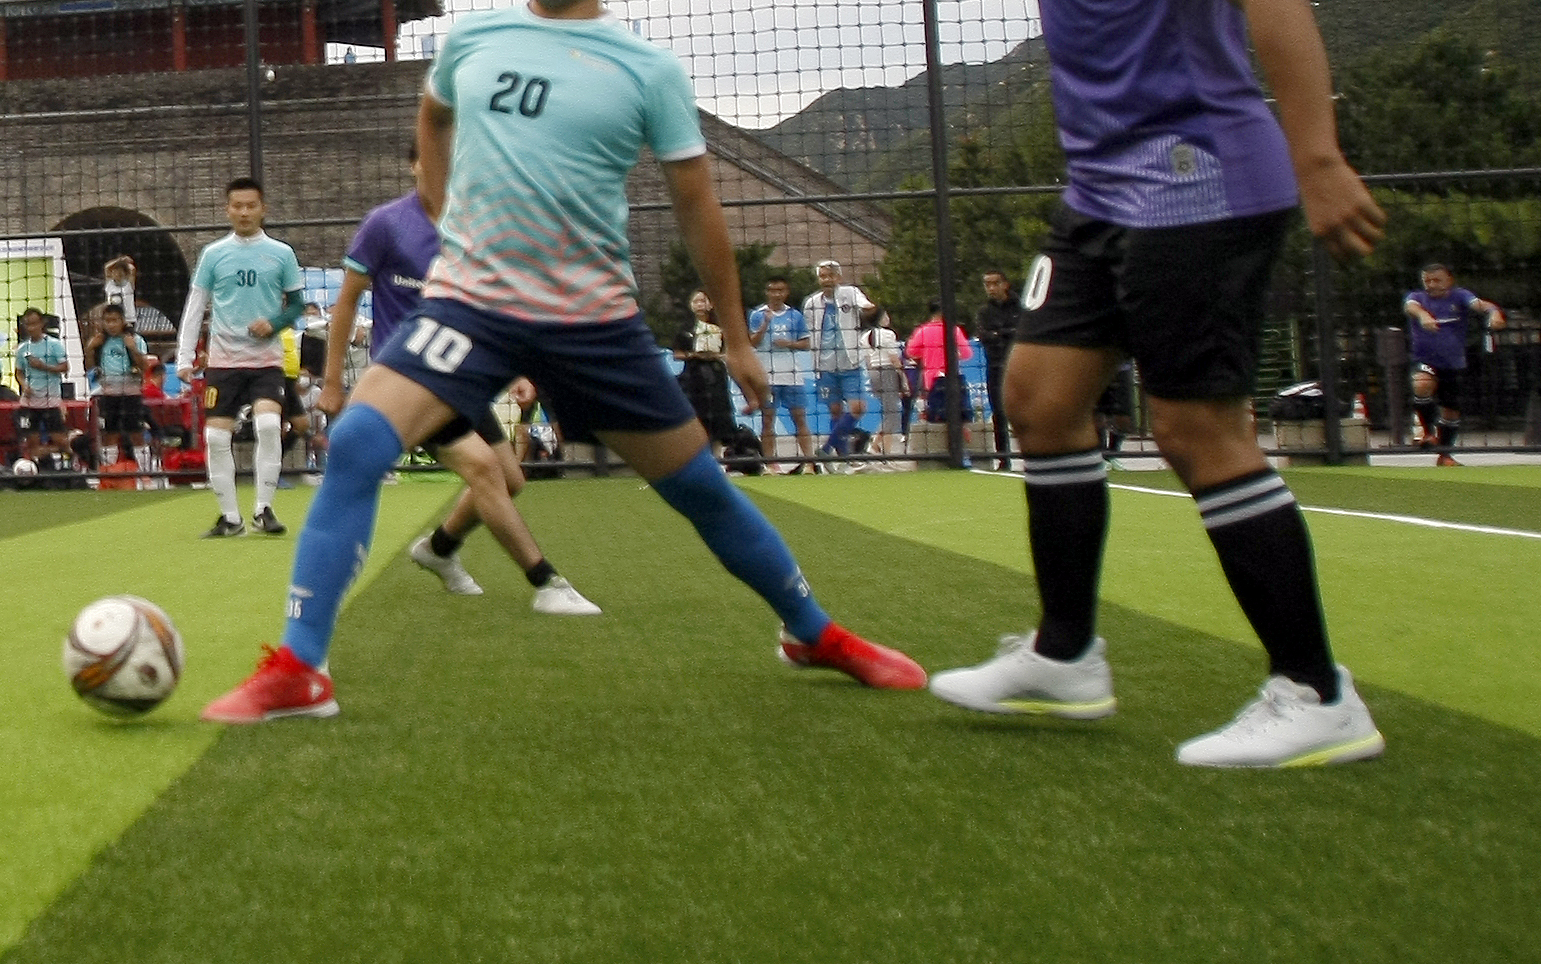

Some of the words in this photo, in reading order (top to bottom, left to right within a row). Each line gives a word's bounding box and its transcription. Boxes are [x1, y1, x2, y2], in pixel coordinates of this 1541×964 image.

[488, 70, 552, 118] 20
[237, 269, 257, 287] 30
[405, 316, 474, 374] 10
